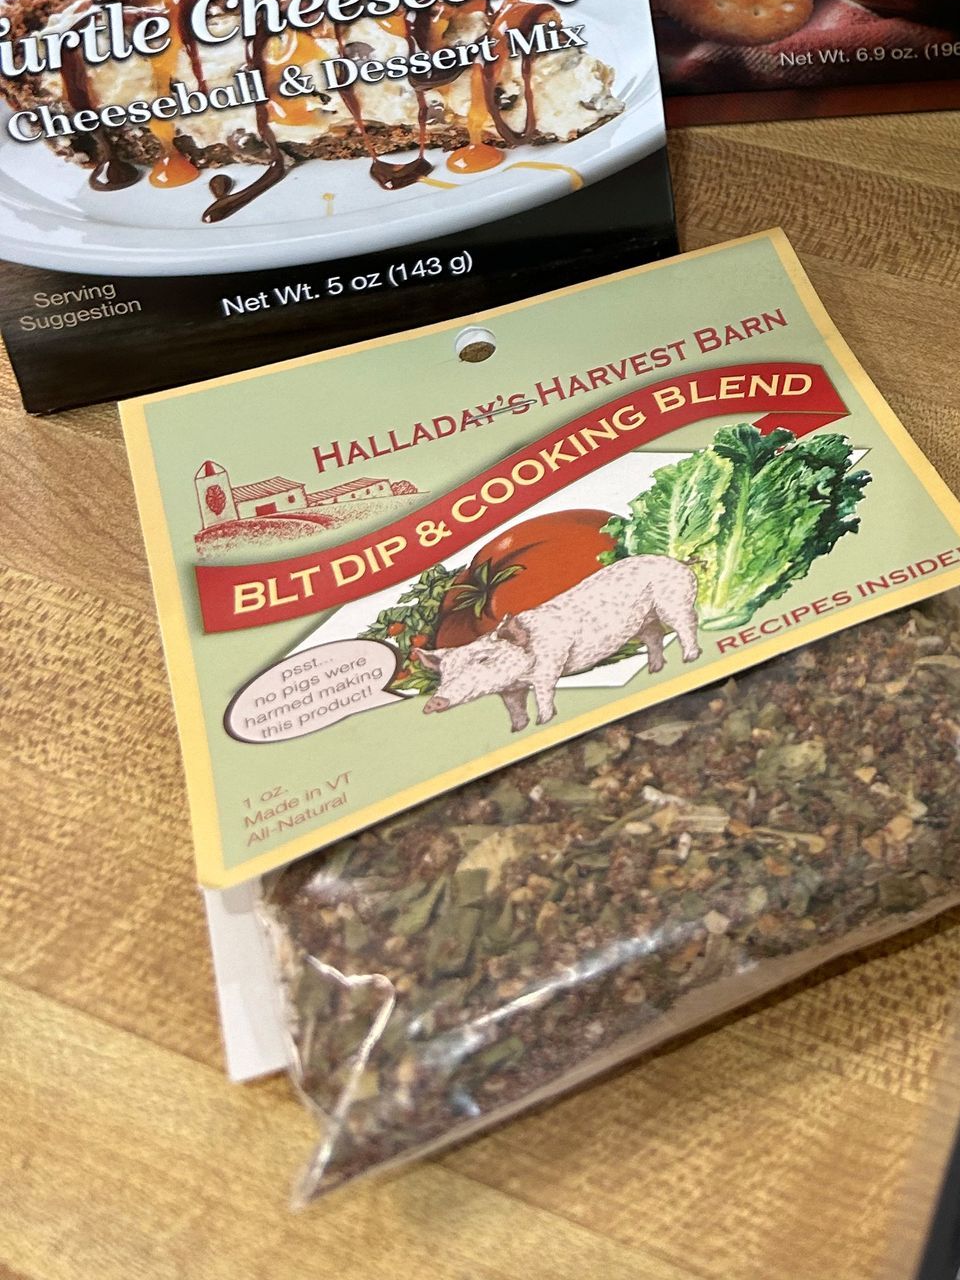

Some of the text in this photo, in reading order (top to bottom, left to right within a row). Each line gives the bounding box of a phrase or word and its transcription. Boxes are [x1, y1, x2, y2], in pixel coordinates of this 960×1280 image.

[0, 1, 172, 77] urtle
[780, 51, 814, 67] Net
[818, 49, 850, 64] Wt.
[856, 46, 886, 61] 6.9
[891, 46, 919, 60] oz.
[6, 18, 589, 144] Cheeseball & Dessert Mix
[33, 282, 117, 311] Serving
[221, 250, 475, 317] Net Wt. 5 oz (143 g)
[19, 297, 143, 333] Suggestion
[535, 340, 688, 407] HARVEST
[693, 308, 790, 354] BARN
[231, 372, 814, 616] BLT DIP & COOKING BLEND
[715, 589, 853, 656] RECIPES
[244, 666, 384, 730] harmed making
[254, 656, 368, 708] no pigs were
[261, 684, 374, 739] this product!
[242, 785, 289, 809] 1 oz.
[242, 769, 353, 828] Made in VT
[246, 791, 348, 847] All-Natural
